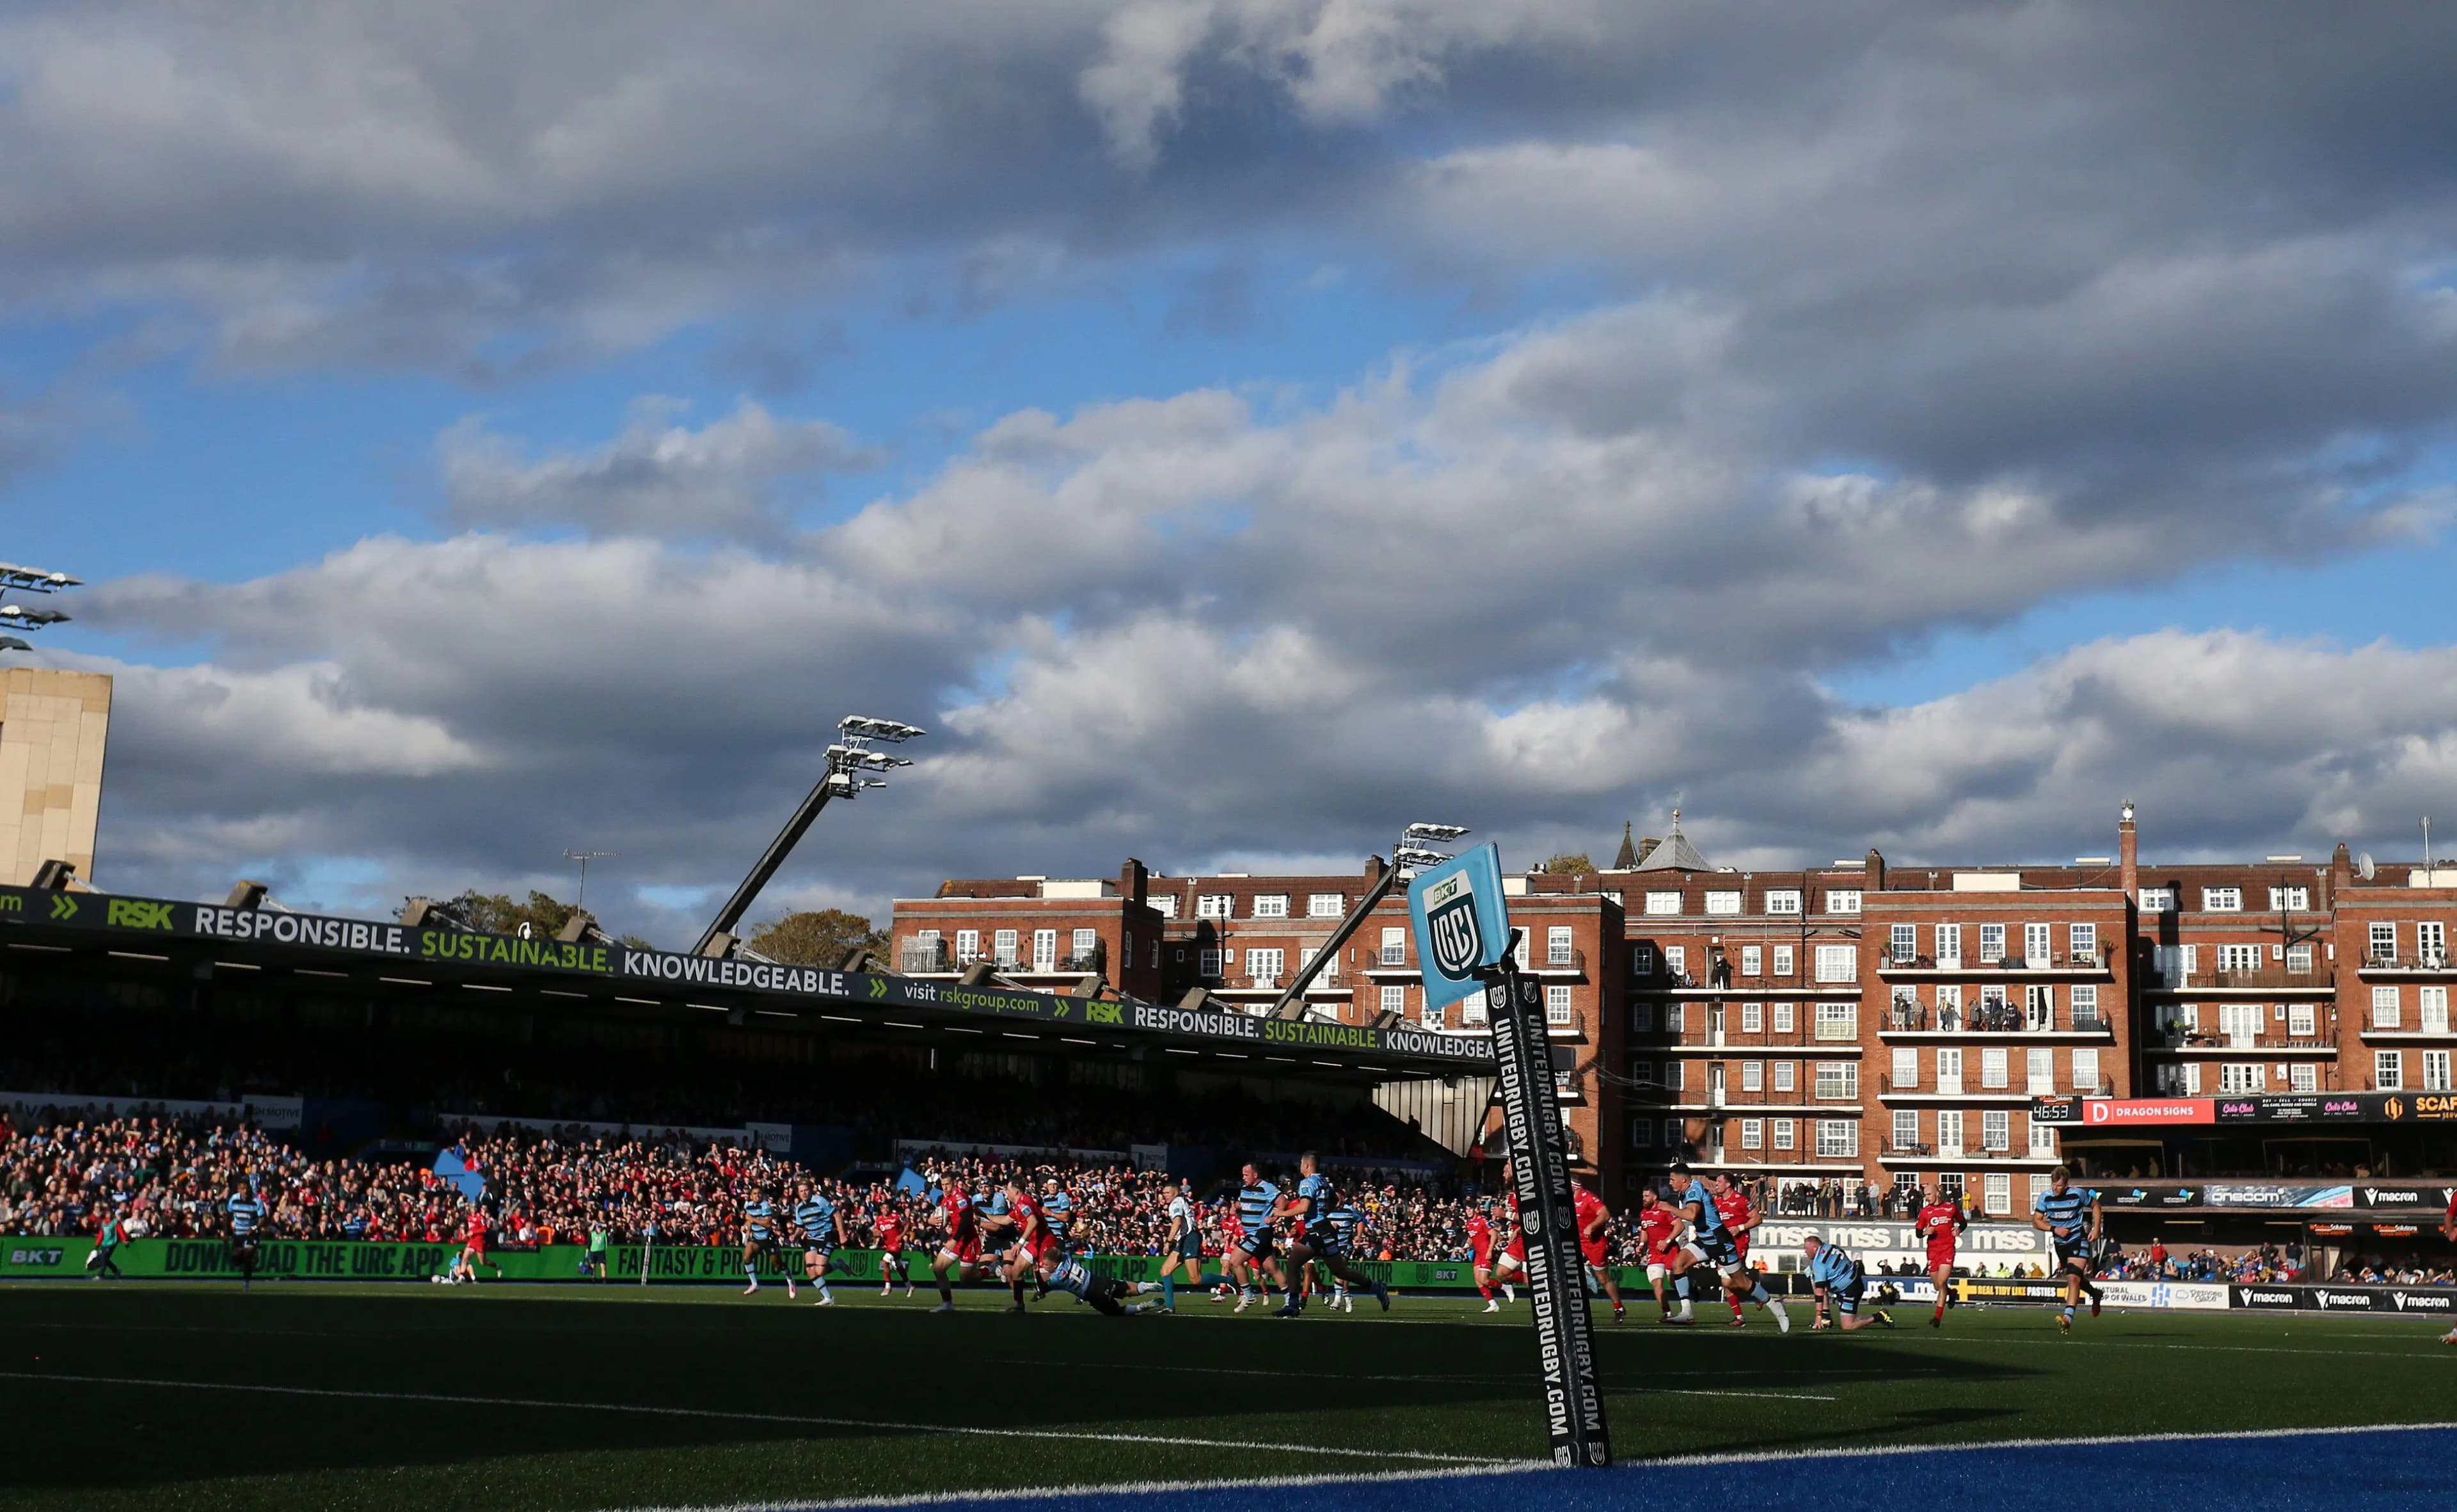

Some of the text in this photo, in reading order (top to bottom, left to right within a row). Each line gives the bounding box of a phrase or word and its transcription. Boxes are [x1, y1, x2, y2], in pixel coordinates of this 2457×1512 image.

[1433, 877, 1458, 905] BKT
[107, 898, 850, 996] RSK RESPONSIBLE. SUSTAINABLE. KNOWLEDGEABLE.
[904, 983, 1040, 1013] visit rskgroup.com
[1086, 1001, 1124, 1024] RSK
[1134, 1007, 1259, 1039] RESPONSIBLE.
[1264, 1022, 1380, 1049] SUSTAINABLE.
[1495, 1018, 1536, 1202] UNITEDRUGBY.COM
[1527, 1014, 1567, 1196] UNITEDRUGBY.COM
[2033, 1105, 2069, 1118] 46:53
[2117, 1106, 2193, 1116] DRAGON SIGNS
[2211, 1192, 2278, 1202] onecom
[2378, 1192, 2417, 1202] macron
[1829, 1227, 1891, 1248] mss
[1973, 1229, 2035, 1250] mss
[10, 1250, 62, 1264] BKT
[164, 1243, 443, 1275] DOWNOAD THE URC APP
[702, 1249, 713, 1275] &
[1122, 1259, 1147, 1280] APP
[1436, 1271, 1456, 1280] BKT
[1978, 1285, 1994, 1295] REAL
[2012, 1286, 2026, 1296] LIKE
[2027, 1287, 2055, 1297] PASTIES
[2252, 1293, 2293, 1303] macron
[2328, 1295, 2369, 1305] macron
[2407, 1297, 2449, 1308] macron
[1529, 1246, 1570, 1436] UNITEDRUGBY.COM
[1561, 1241, 1601, 1431] UNITEDRUGBY.COM
